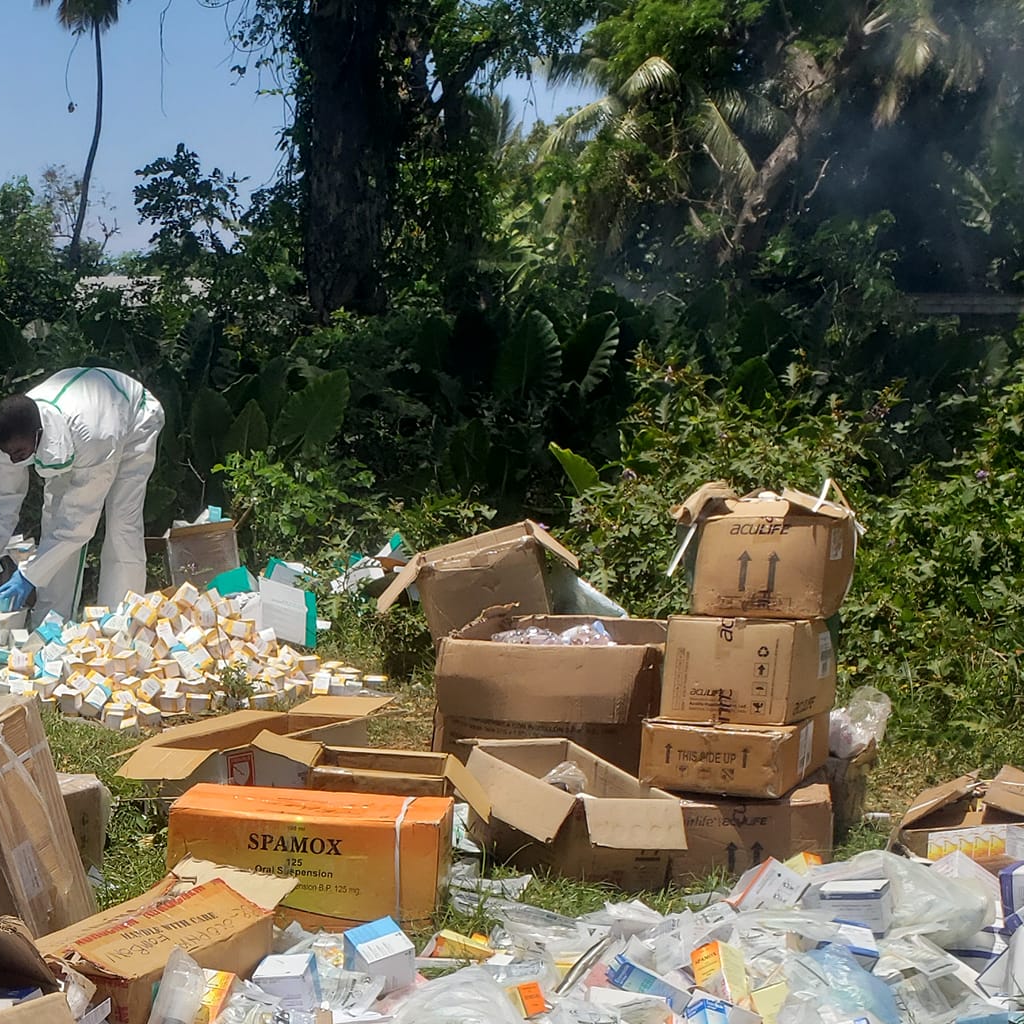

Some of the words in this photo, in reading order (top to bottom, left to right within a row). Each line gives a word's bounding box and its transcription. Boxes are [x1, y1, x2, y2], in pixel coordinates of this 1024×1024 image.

[247, 832, 344, 857] SPAMOX
[286, 858, 303, 868] 125
[121, 925, 162, 942] HANDLE
[163, 917, 191, 934] WITH
[191, 911, 219, 928] CARE
